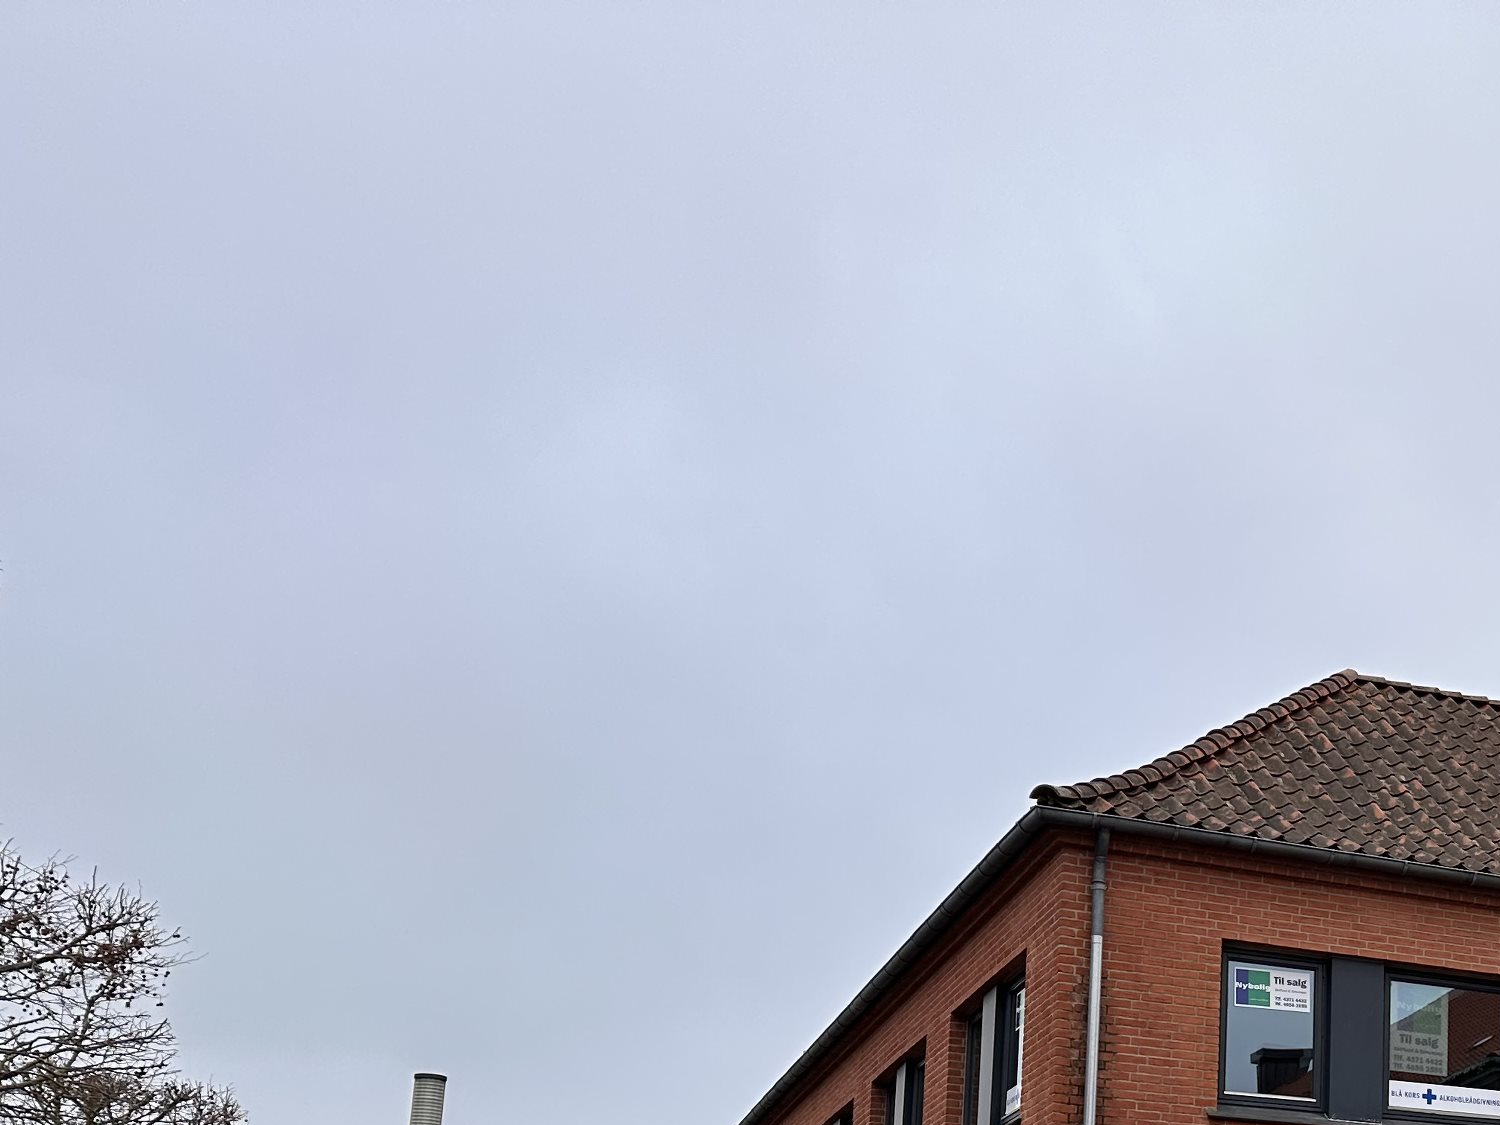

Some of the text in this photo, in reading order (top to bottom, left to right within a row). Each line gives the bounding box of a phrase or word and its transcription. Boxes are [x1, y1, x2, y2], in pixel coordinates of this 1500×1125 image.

[1235, 982, 1271, 993] Nybolig
[1274, 976, 1307, 989] Til salg
[1400, 1033, 1439, 1050] Til salg
[1391, 1090, 1500, 1107] BLÅ KORS ALKOHOLRÅDGIVNING
